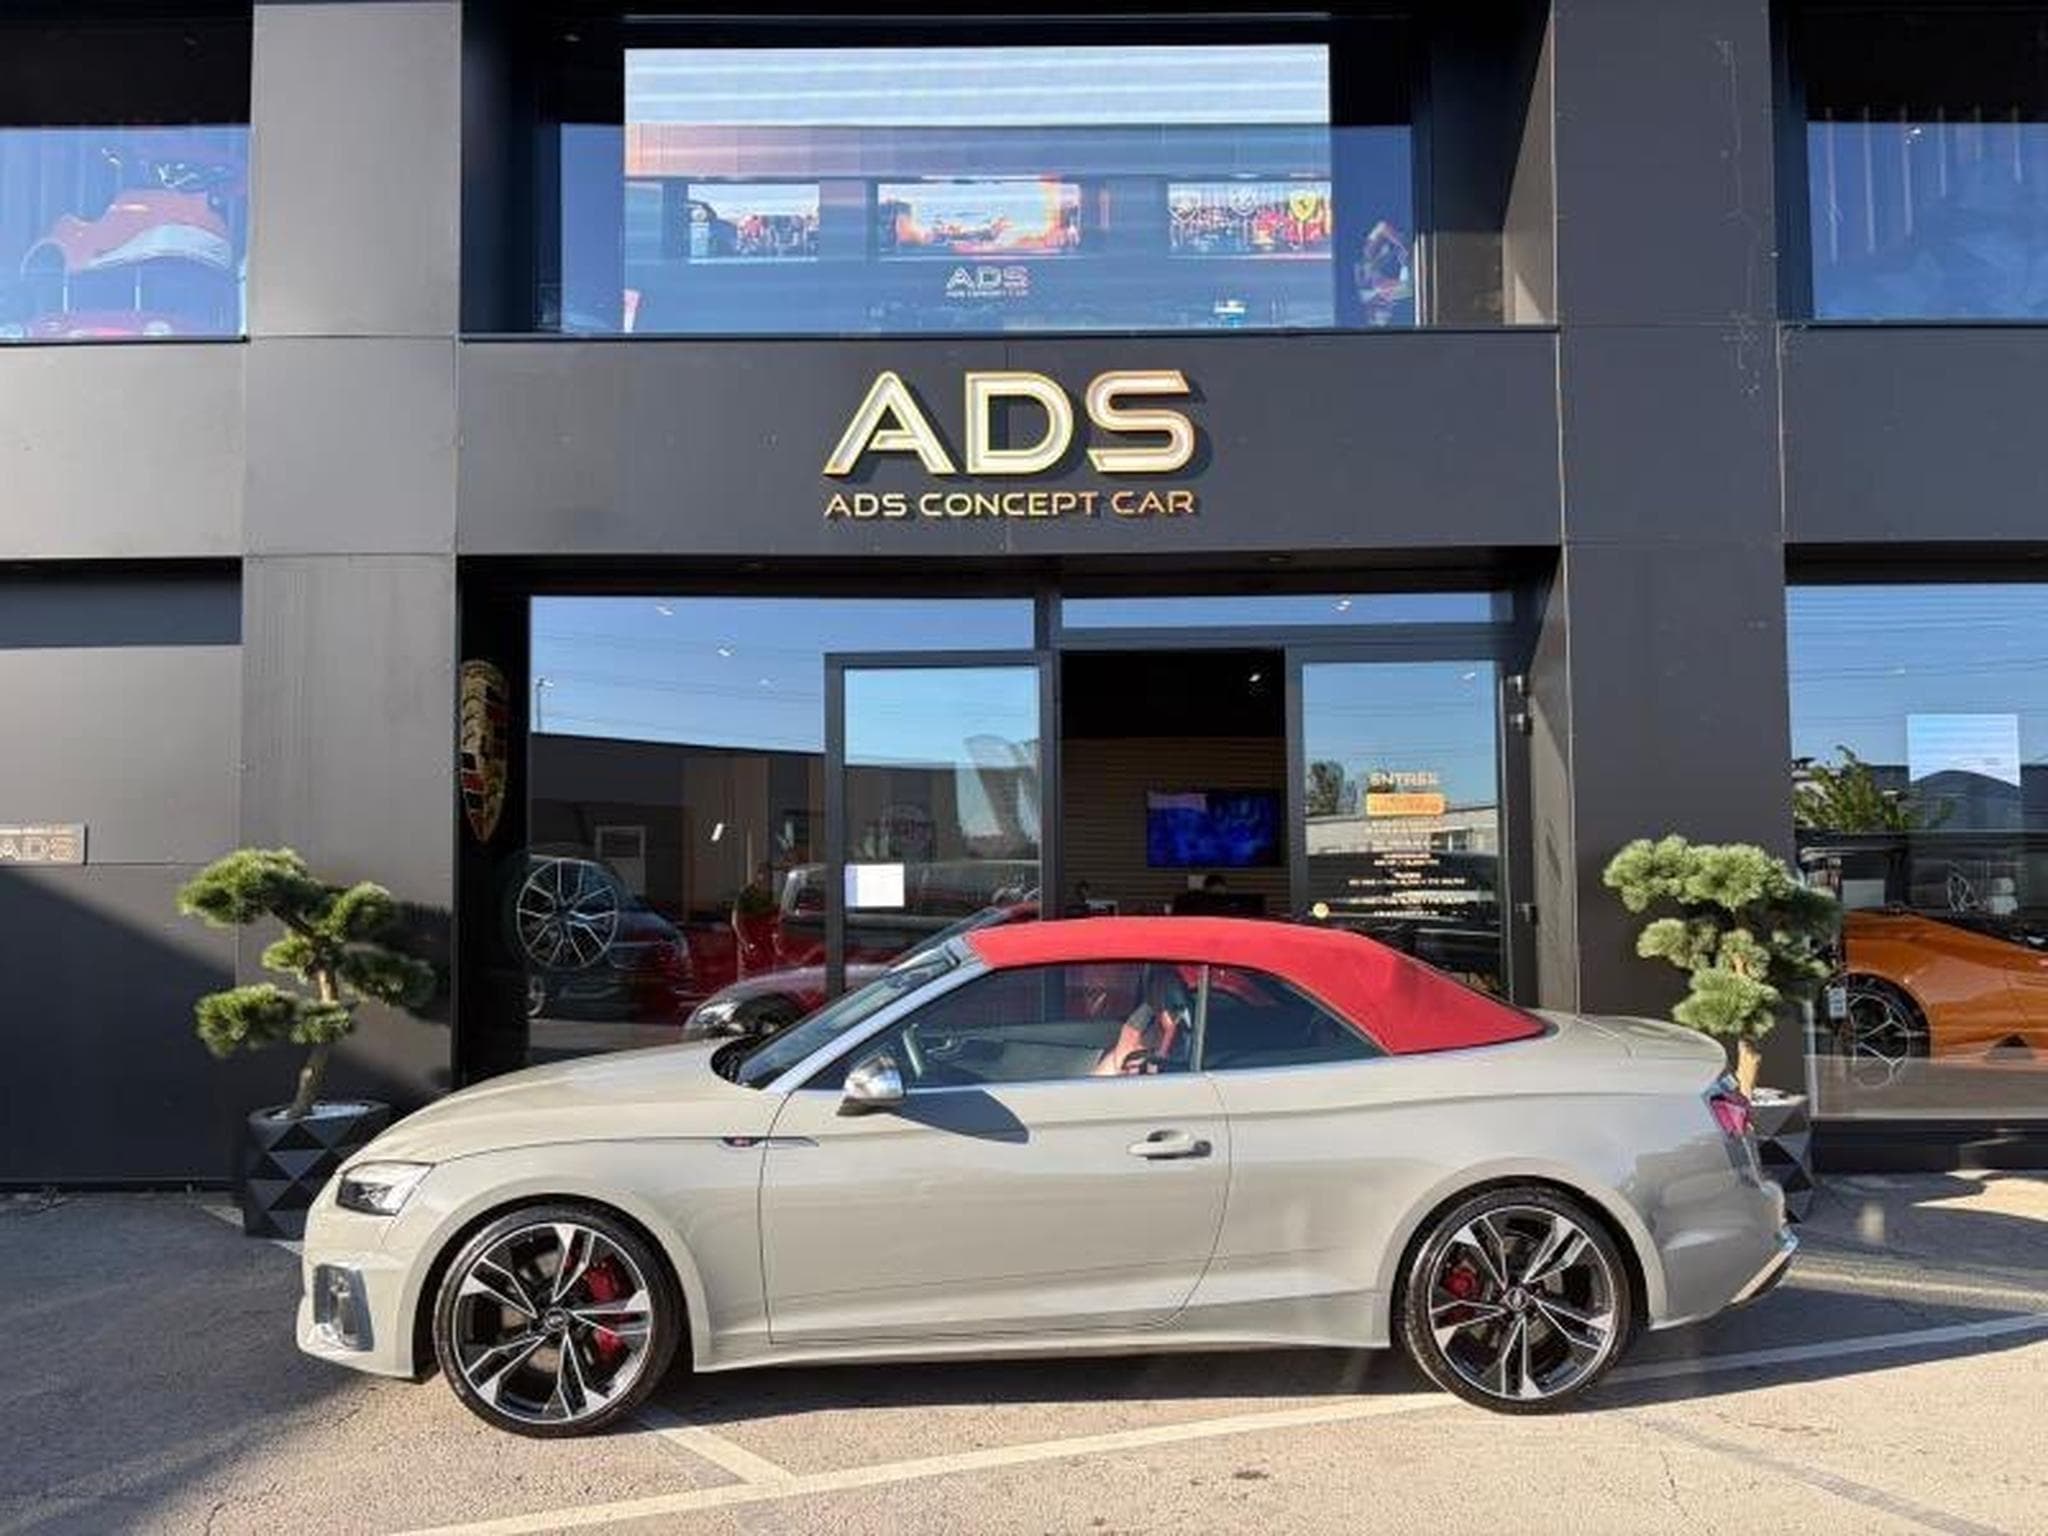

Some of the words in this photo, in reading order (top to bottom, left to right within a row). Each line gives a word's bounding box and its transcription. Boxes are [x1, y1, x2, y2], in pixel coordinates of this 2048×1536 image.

[946, 265, 1029, 290] ADS
[822, 370, 1195, 475] ADS
[825, 492, 907, 517] ADS
[919, 491, 1099, 517] CONCEPT
[1111, 490, 1194, 515] CAR
[0, 836, 77, 861] ADS
